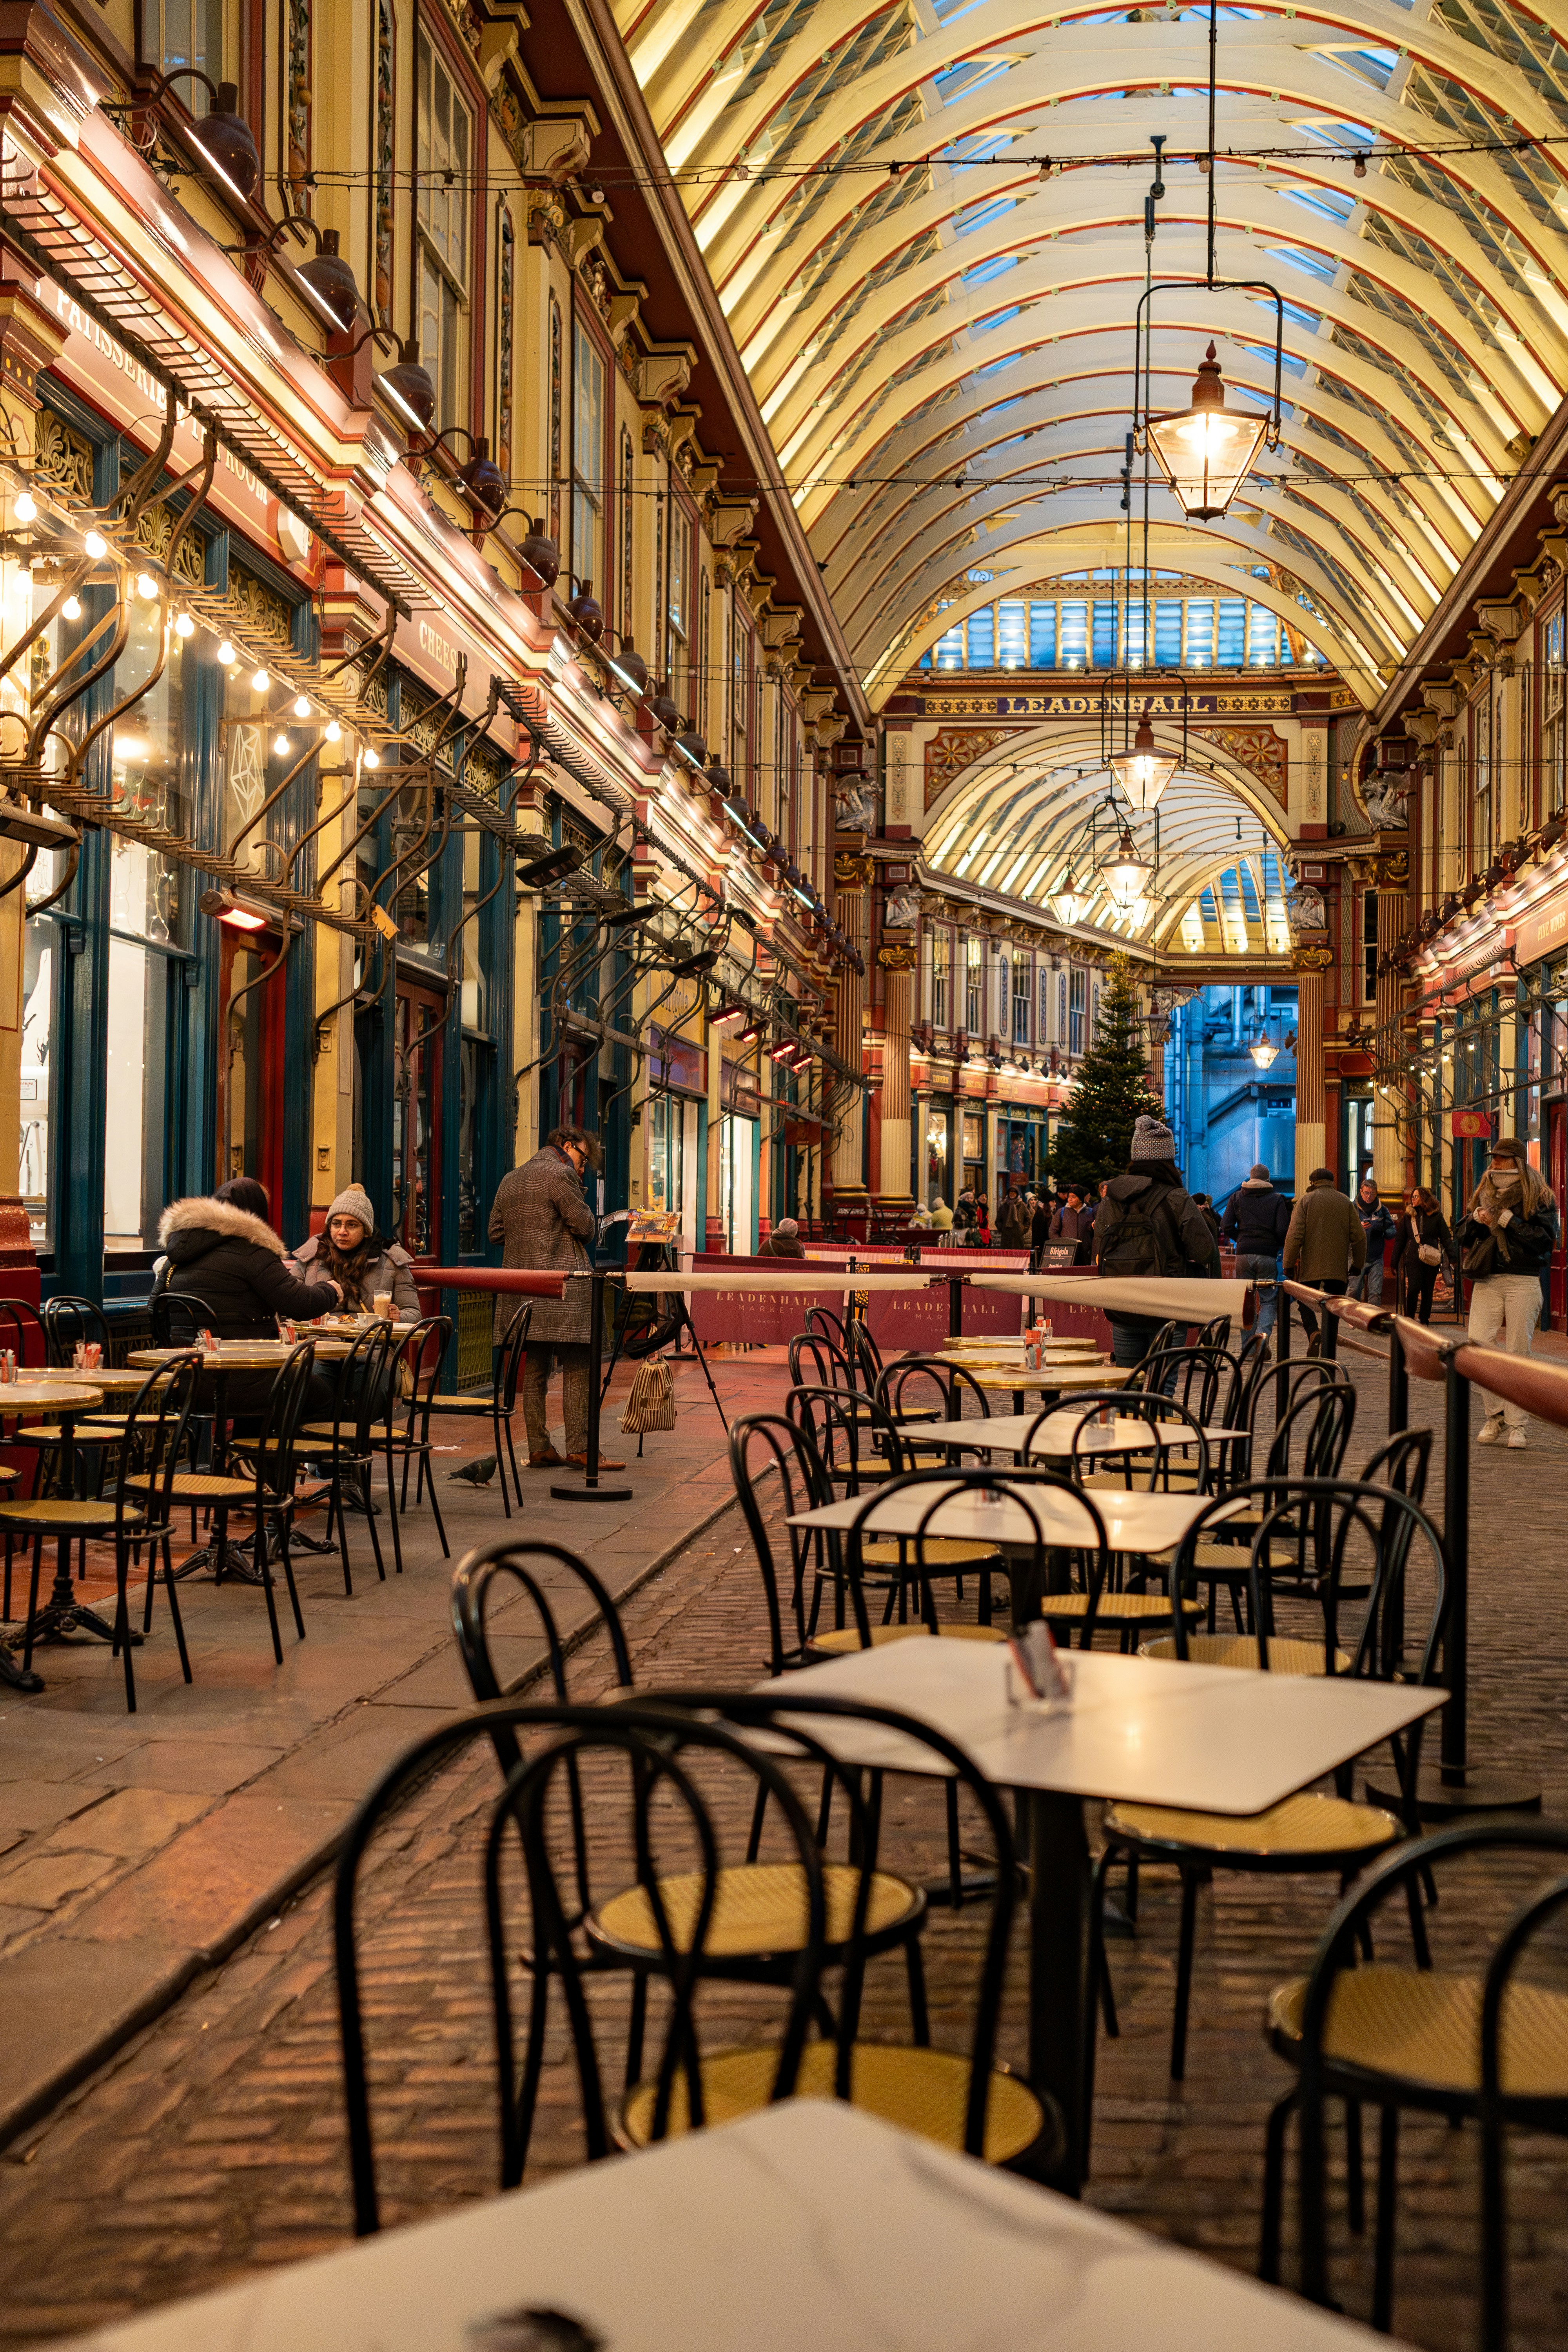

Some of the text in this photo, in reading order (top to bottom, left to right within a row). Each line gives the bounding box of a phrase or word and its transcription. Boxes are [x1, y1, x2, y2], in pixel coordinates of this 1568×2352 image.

[419, 619, 464, 679] CHEES
[1006, 697, 1209, 714] LEADENHALL
[1537, 910, 1566, 941] FINE WINES
[716, 1291, 820, 1307] LEADENHALL
[738, 1304, 794, 1314] MARKET
[893, 1301, 998, 1314] LEADEALL
[915, 1314, 971, 1322] MART
